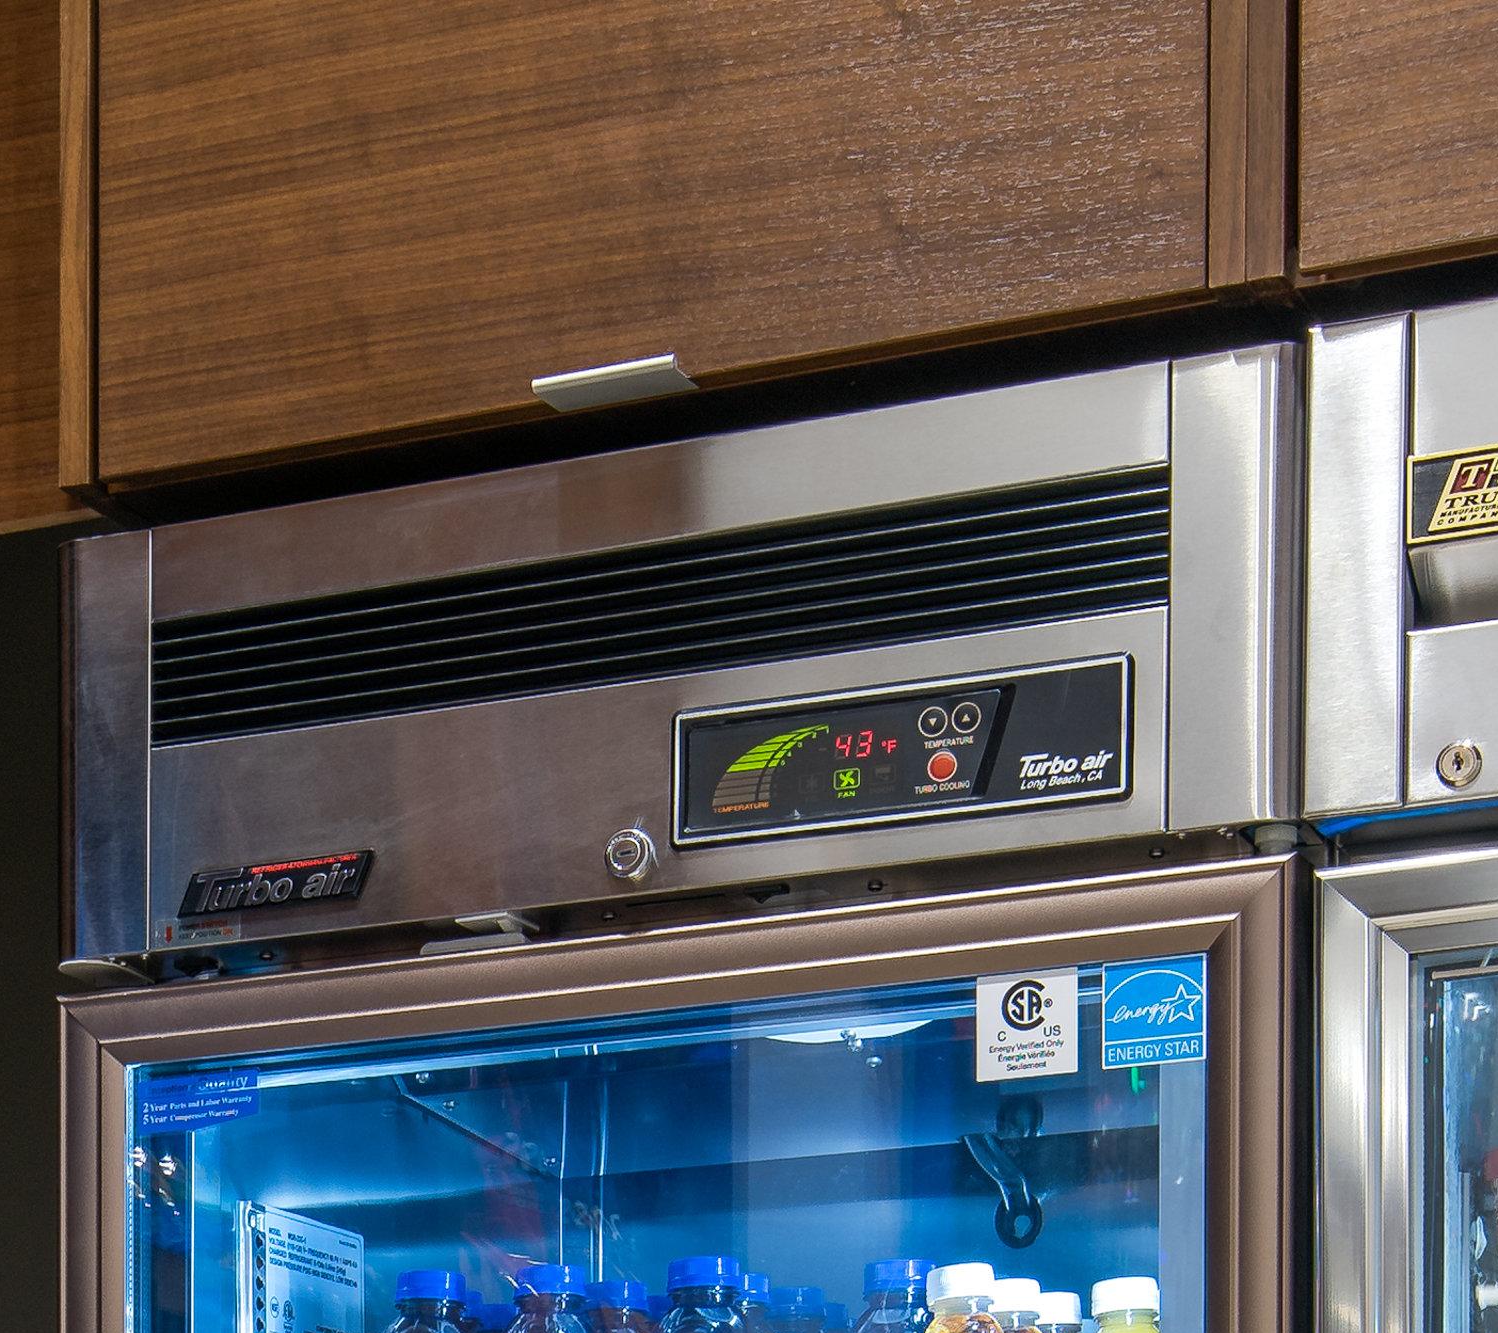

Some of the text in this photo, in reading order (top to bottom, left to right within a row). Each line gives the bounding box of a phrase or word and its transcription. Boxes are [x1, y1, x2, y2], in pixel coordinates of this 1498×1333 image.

[1459, 462, 1490, 490] T
[835, 728, 874, 759] 43
[923, 736, 975, 750] TEMPERATURE
[1018, 750, 1114, 778] Turbo air
[1019, 768, 1103, 792] Long CA
[837, 789, 857, 799] FAN
[714, 800, 772, 813] TEMPERATURE
[195, 866, 294, 913] Turbo
[302, 862, 355, 900] air
[1043, 1024, 1062, 1037] US
[1108, 1040, 1200, 1062] ENERGY STAR
